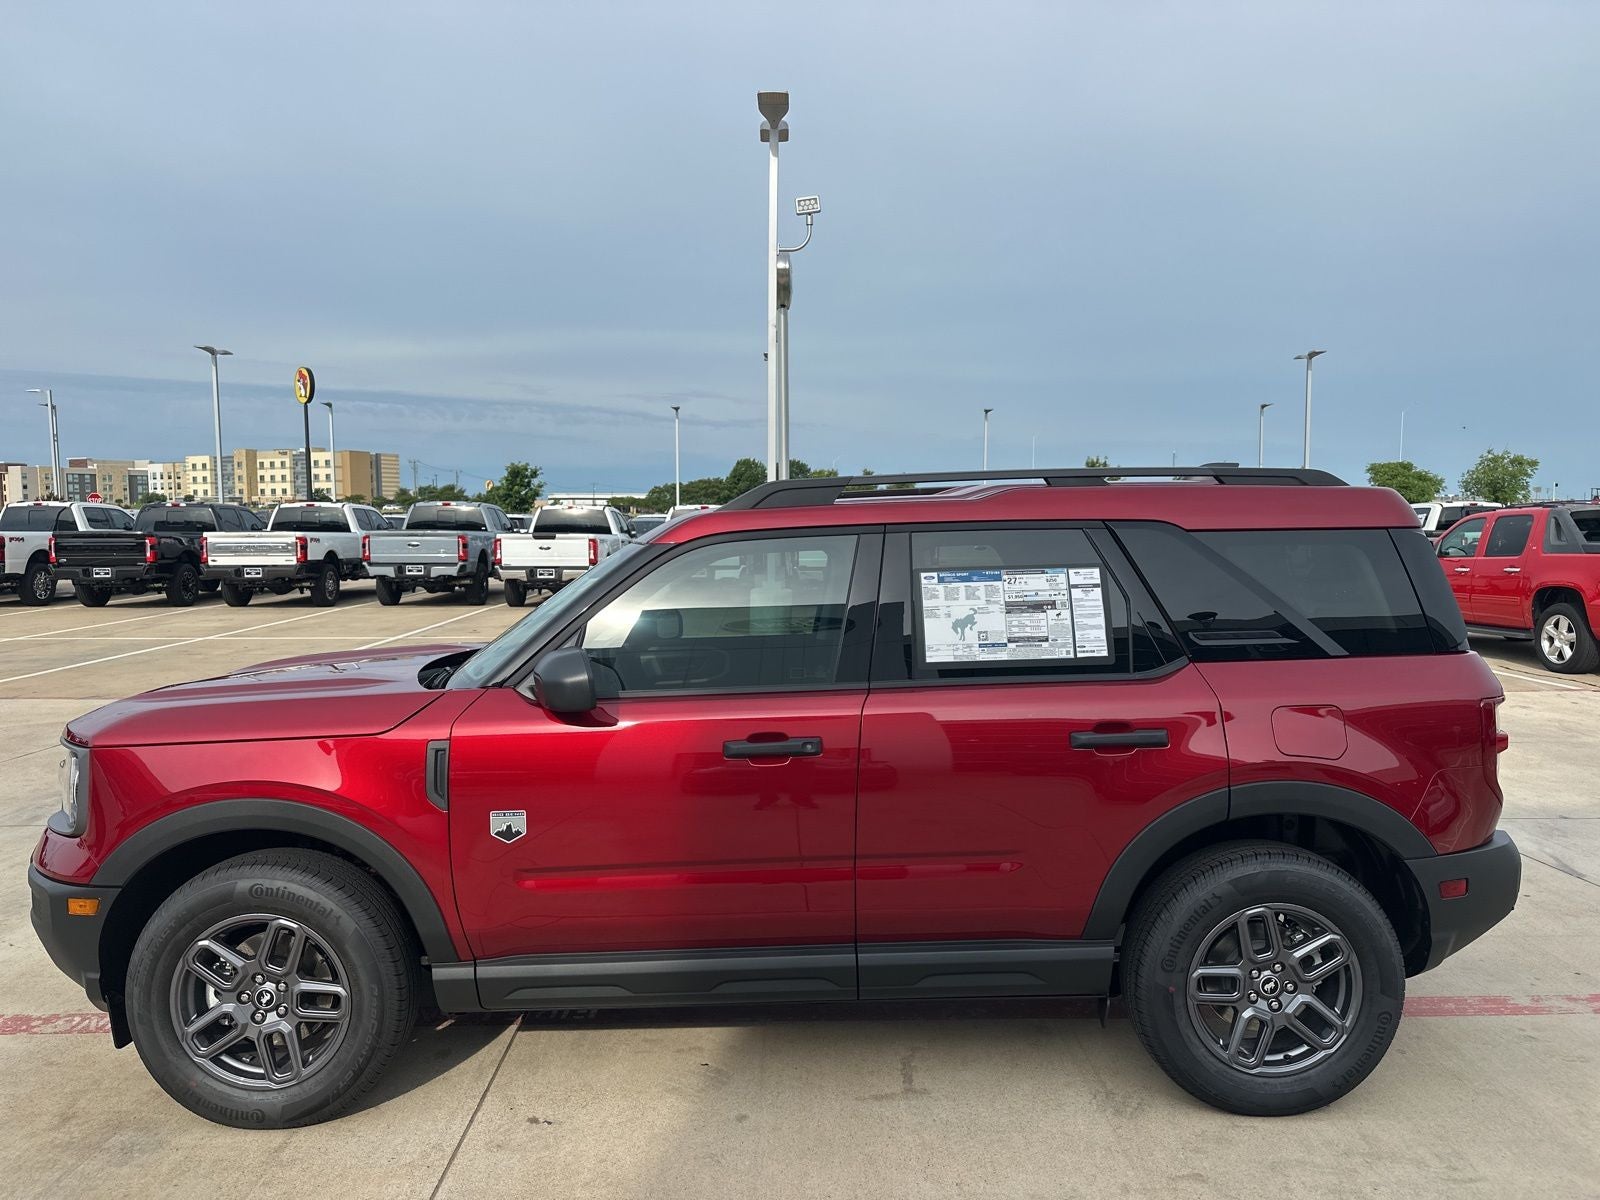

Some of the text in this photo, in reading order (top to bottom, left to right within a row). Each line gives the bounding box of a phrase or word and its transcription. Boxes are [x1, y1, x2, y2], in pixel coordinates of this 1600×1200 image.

[1007, 577, 1017, 585] 27
[248, 883, 331, 919] Continental
[1161, 901, 1216, 974] Continental
[1340, 1010, 1393, 1083] Continental
